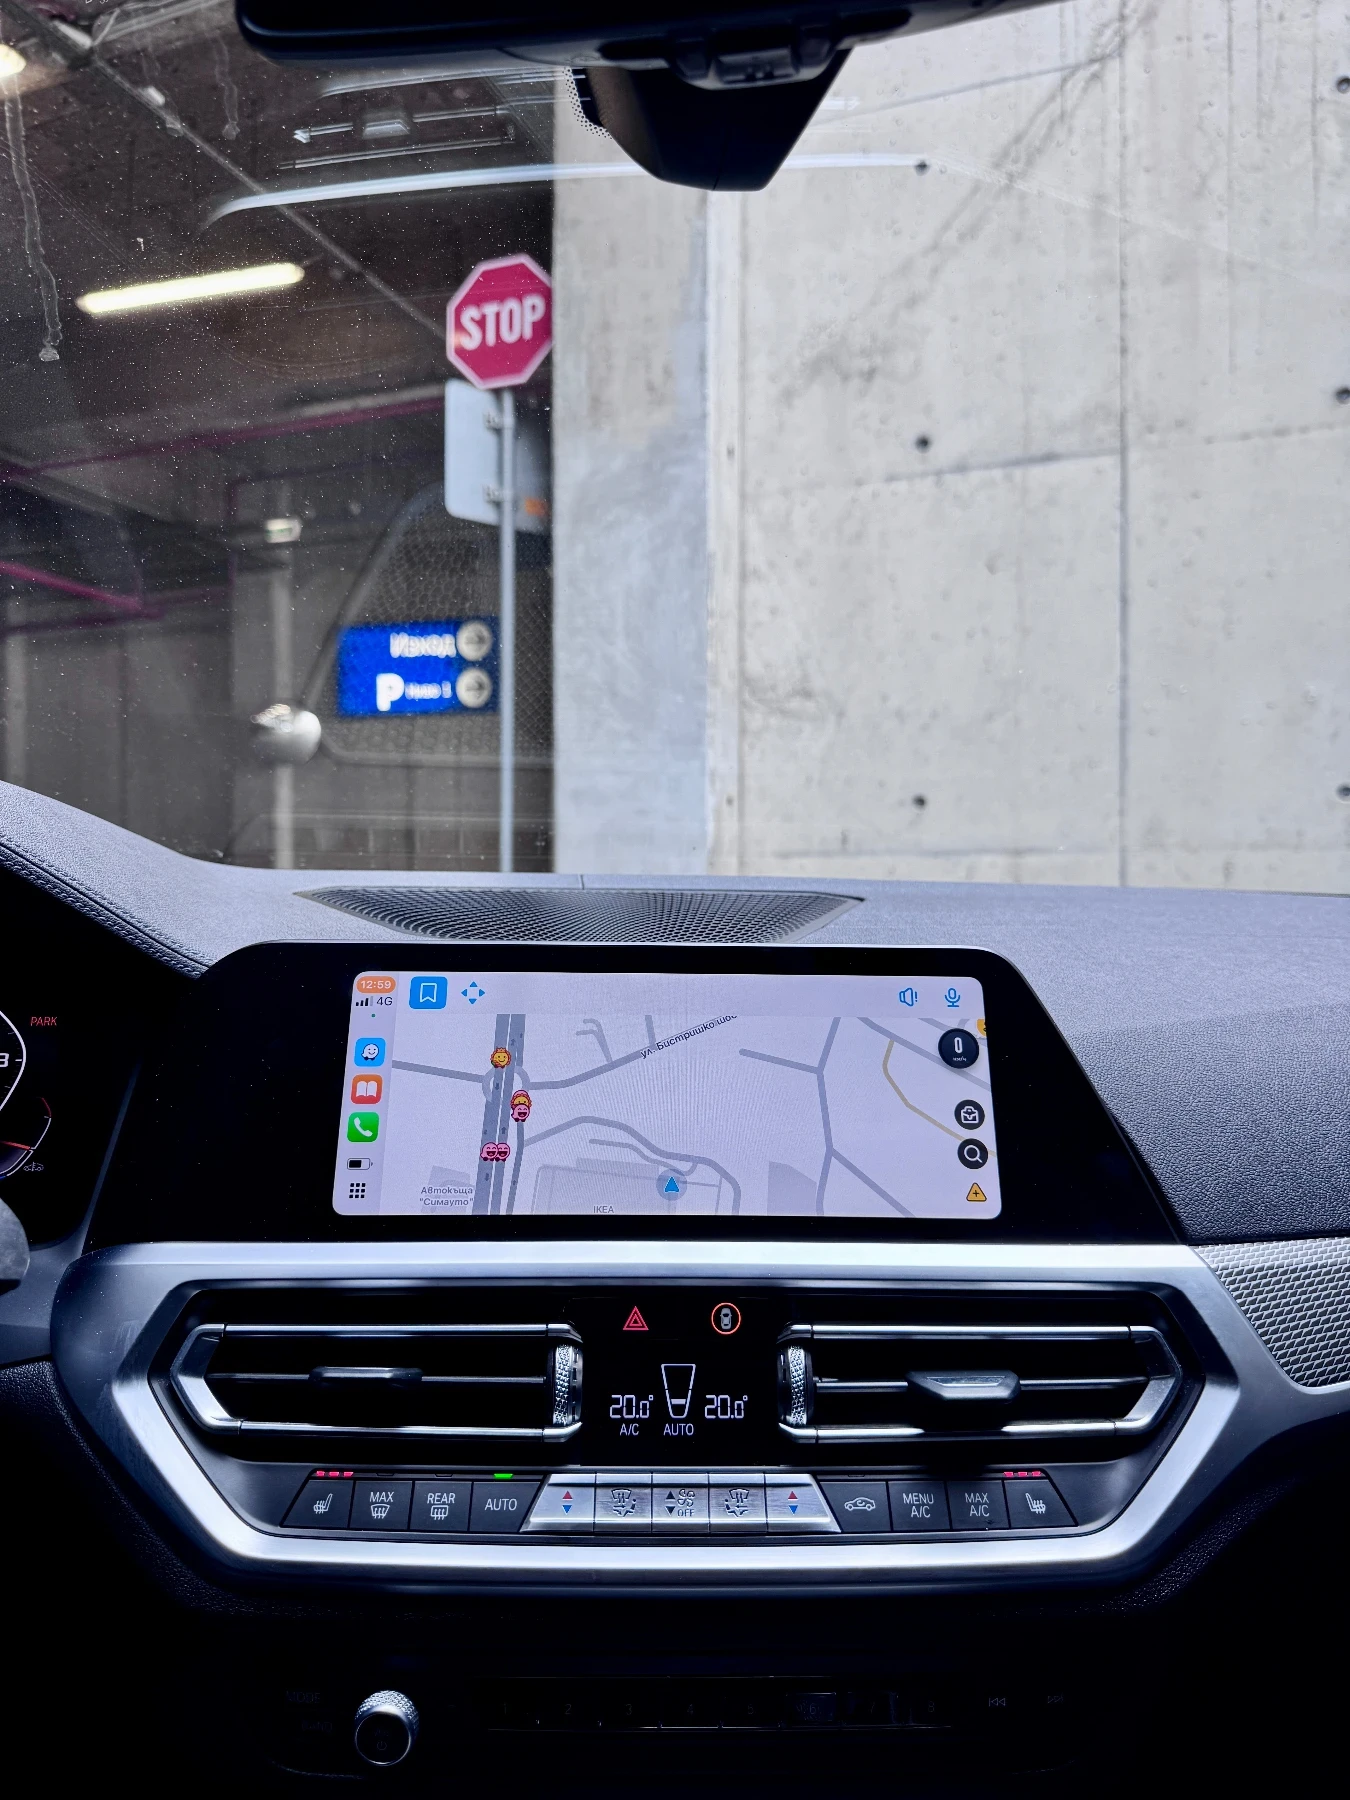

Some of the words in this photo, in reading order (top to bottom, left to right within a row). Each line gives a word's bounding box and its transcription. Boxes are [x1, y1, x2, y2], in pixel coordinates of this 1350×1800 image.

[460, 293, 546, 351] STOP
[376, 672, 404, 712] P
[361, 980, 392, 989] 12:59
[376, 996, 393, 1006] 4G
[30, 1016, 58, 1026] PARK
[640, 1048, 656, 1059] ул.
[656, 1021, 715, 1050] Бистришко
[954, 1037, 963, 1054] 0
[421, 1186, 473, 1195] Автокъща
[420, 1198, 474, 1207] "Симауто"
[593, 1205, 614, 1214] IKEA
[620, 1423, 639, 1436] A/C
[663, 1423, 694, 1436] AUTO
[369, 1491, 394, 1503] MAX
[427, 1493, 456, 1504] REAR
[903, 1493, 934, 1504] MENU
[965, 1492, 989, 1503] MAX
[484, 1498, 518, 1511] AUTO
[677, 1508, 695, 1517] OFF
[911, 1506, 931, 1518] A/C
[969, 1505, 989, 1517] A/C
